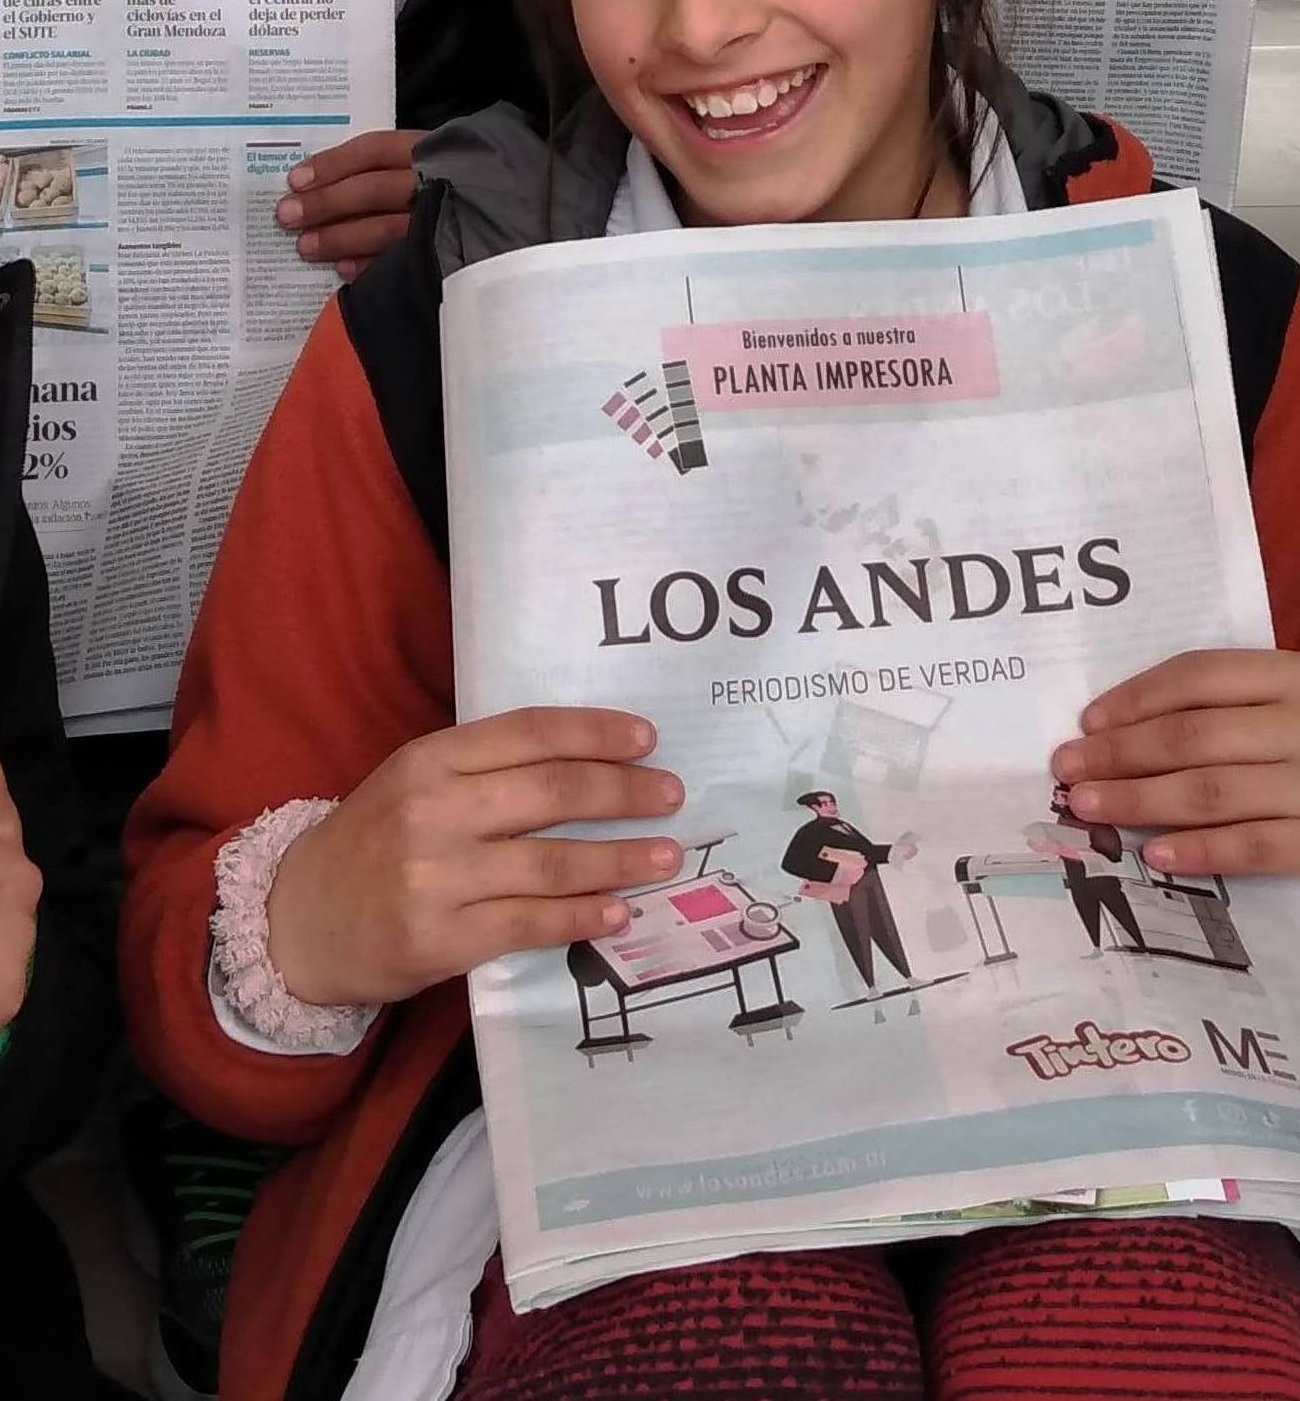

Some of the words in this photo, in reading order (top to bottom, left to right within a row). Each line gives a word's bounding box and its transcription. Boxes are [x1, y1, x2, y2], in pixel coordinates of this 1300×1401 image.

[3, 11, 16, 24] el
[19, 9, 84, 24] Gobierno
[87, 12, 95, 25] y
[126, 8, 186, 22] ciclovías
[189, 11, 206, 22] en
[209, 8, 222, 22] el
[248, 8, 277, 24] deja
[280, 8, 297, 21] de
[300, 8, 346, 24] perder
[3, 27, 16, 40] el
[18, 26, 58, 39] SUTE
[126, 24, 161, 38] Gran
[164, 24, 226, 38] Mendoza
[248, 24, 299, 38] dólares
[50, 50, 92, 59] SALARIAL
[139, 49, 171, 58] CIUDAD
[249, 48, 291, 57] RESERVAS
[247, 152, 256, 162] El
[742, 328, 839, 351] Bienvenidos
[842, 331, 853, 347] a
[856, 326, 917, 347] nuestra
[713, 361, 808, 396] PLANTA
[816, 357, 954, 392] IMPRESORA
[592, 567, 773, 648] LOS
[797, 537, 1133, 635] ANDES
[710, 669, 870, 706] PERIODISMO
[877, 664, 914, 692] DE
[918, 655, 1027, 687] VERDAD
[1006, 1019, 1191, 1080] Tintero
